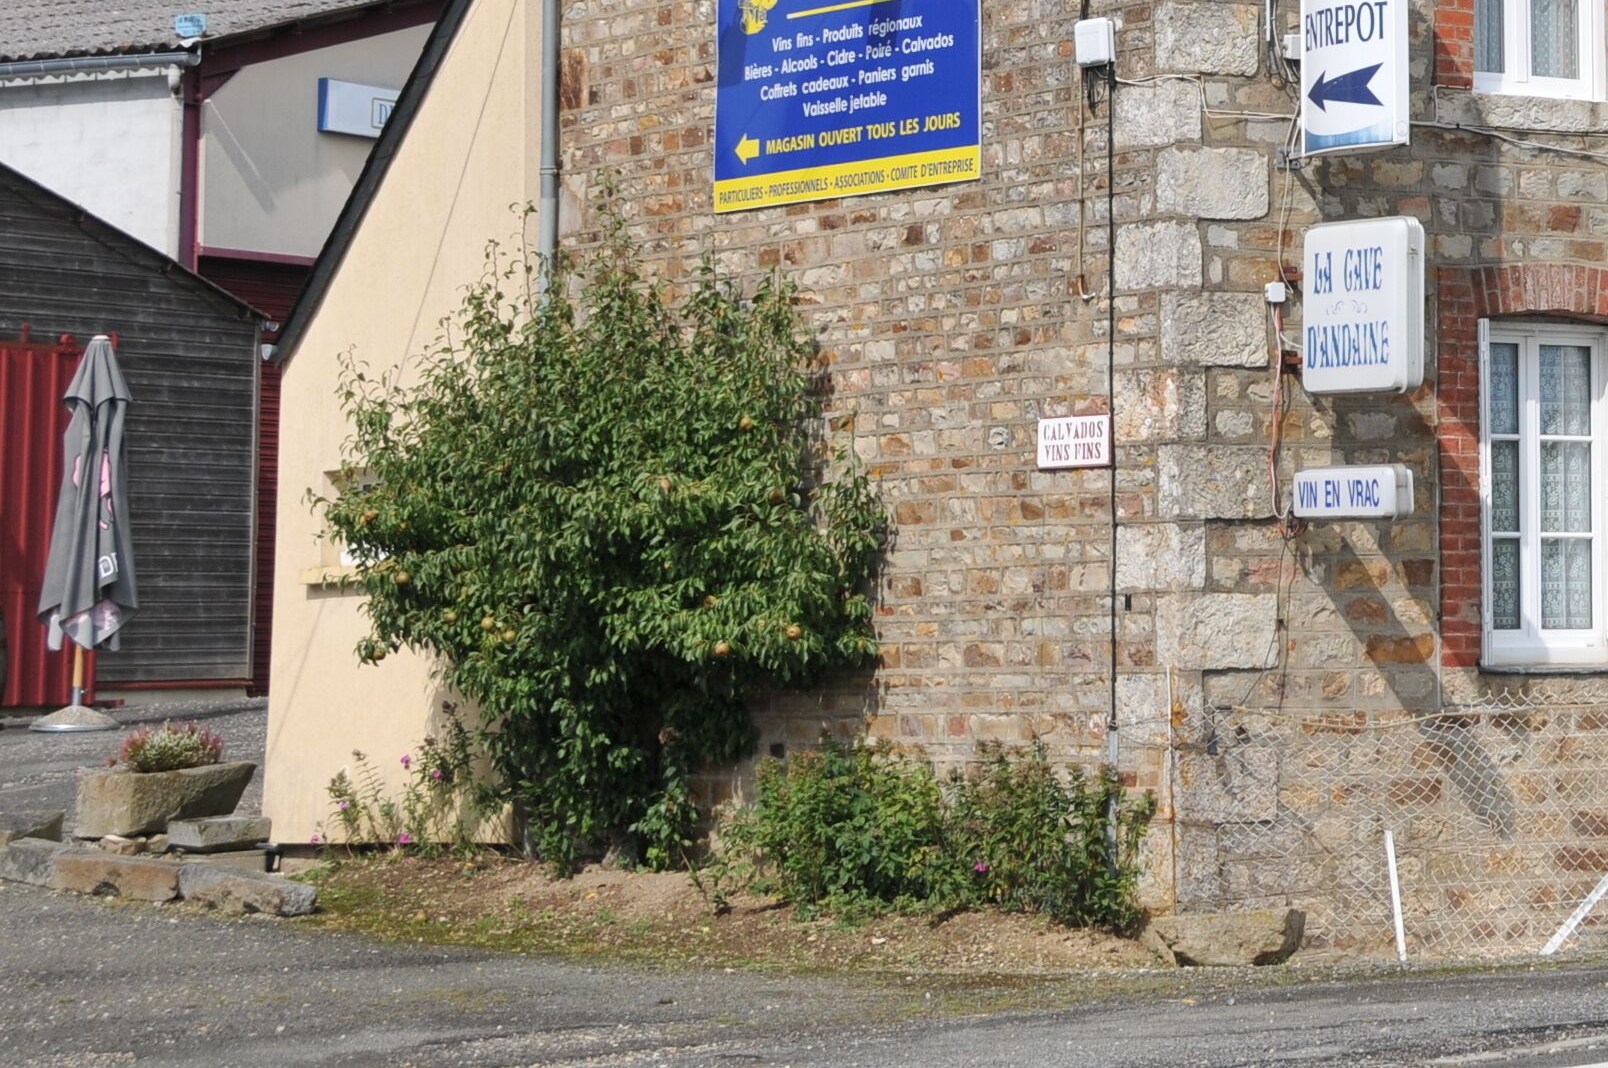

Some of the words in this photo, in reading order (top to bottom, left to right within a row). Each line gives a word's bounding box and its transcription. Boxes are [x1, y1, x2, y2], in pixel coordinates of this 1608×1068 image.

[772, 38, 792, 52] Vins
[796, 33, 813, 48] fins
[822, 24, 863, 44] Produits
[868, 15, 922, 37] régionaux
[1305, 1, 1388, 52] ENTREPOT
[744, 63, 772, 81] Bières
[781, 55, 818, 74] Alcools
[827, 49, 855, 66] Cidre
[866, 40, 892, 60] Poiré
[902, 33, 954, 54] Calvados
[760, 83, 797, 101] Coffrets
[802, 75, 849, 94] cadeaux
[858, 67, 896, 85] Paniers
[901, 59, 934, 82] garnis
[803, 97, 848, 117] Vaisselle
[849, 91, 887, 113] jetable
[766, 135, 815, 155] MAGASIN
[818, 127, 863, 147] OUVERT
[866, 122, 896, 140] TOUS
[900, 117, 920, 135] LES
[923, 112, 961, 132] JOURS
[719, 186, 763, 205] PARTICULIERS
[768, 178, 828, 197] PROFESSIONNELS
[834, 170, 885, 189] ASSOCIATIONS
[921, 158, 974, 178] D'ENTREPRISE
[1313, 251, 1332, 294] LA
[1343, 246, 1383, 292] CAVE
[1307, 320, 1389, 369] D'ANDAINE
[1043, 421, 1104, 441] CALVADOS
[1044, 444, 1071, 461] VINS
[1074, 442, 1101, 460] FINS
[1298, 481, 1317, 508] VIN
[1325, 480, 1340, 508] EN
[1347, 478, 1380, 507] VRAC
